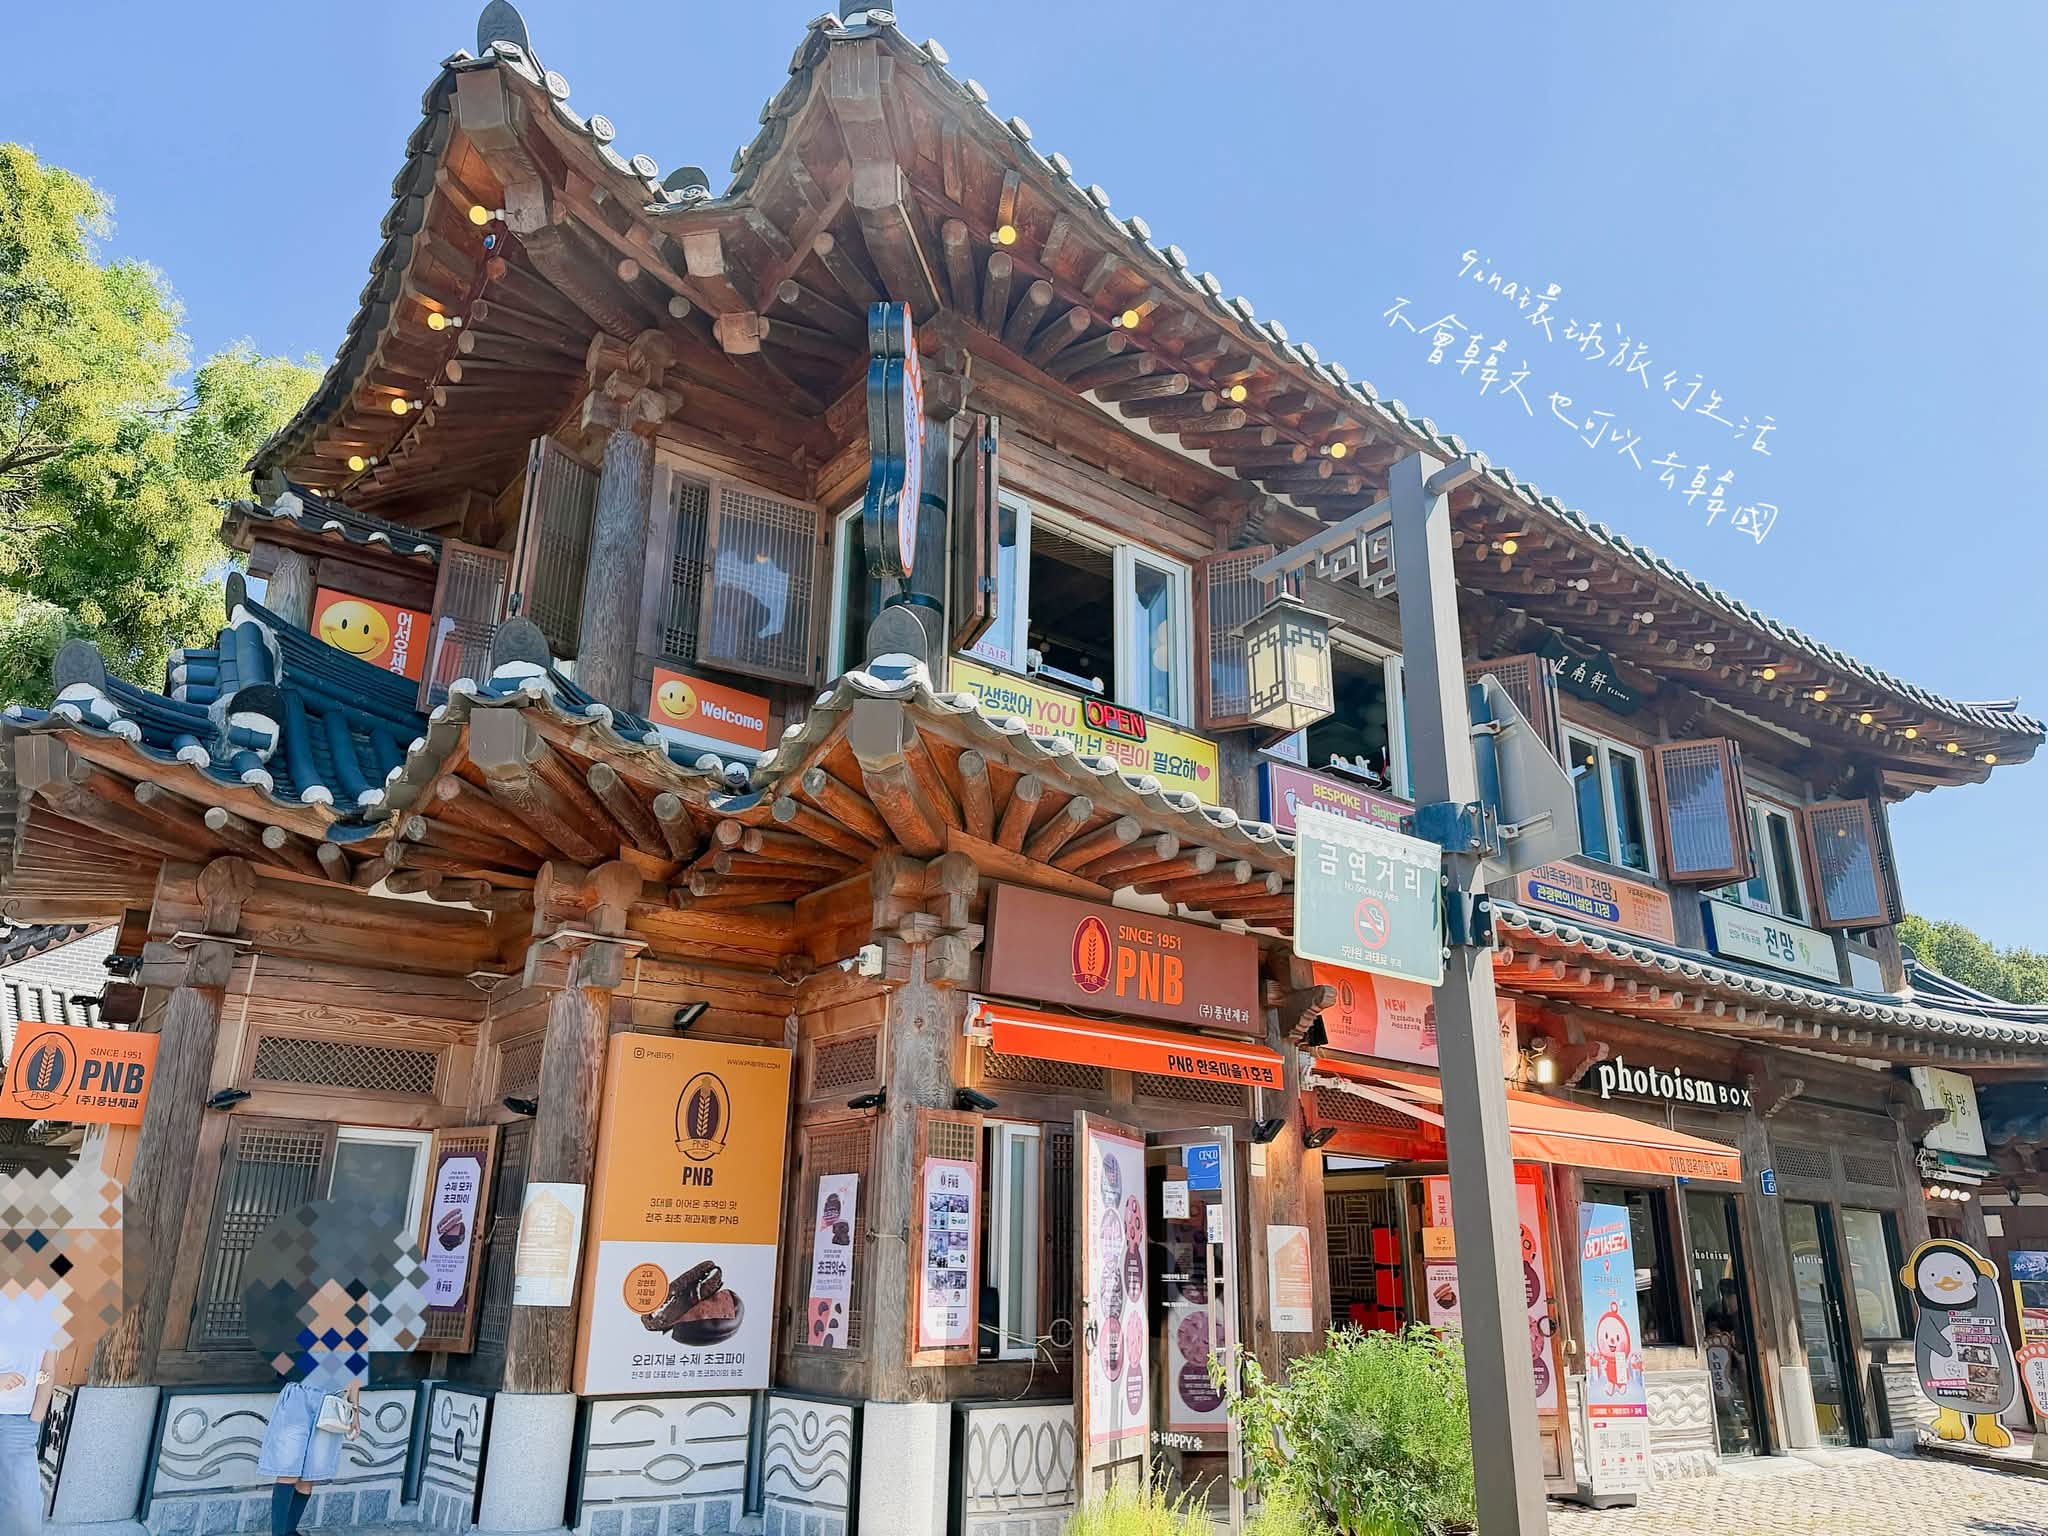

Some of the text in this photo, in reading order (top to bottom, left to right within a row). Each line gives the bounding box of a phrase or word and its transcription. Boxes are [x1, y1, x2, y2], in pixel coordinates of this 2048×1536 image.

[700, 699, 765, 732] Welcome
[1035, 698, 1077, 728] YOU
[1087, 700, 1145, 741] OPEN
[1153, 751, 1197, 781] 필요해
[1312, 783, 1361, 812] BESPOKE
[1317, 843, 1421, 898] 금연거리
[1119, 925, 1183, 950] SINCE 1951
[1762, 926, 1795, 962] 전망
[1115, 946, 1184, 1006] PNB
[1198, 1003, 1249, 1024] (주)풍년제과
[1384, 998, 1407, 1012] NEW
[90, 1047, 142, 1060] SINCE 1951
[1167, 1054, 1194, 1073] PNB
[79, 1059, 145, 1094] PNB
[1599, 1055, 1751, 1107] photoism BOX
[30, 1090, 50, 1100] PNB
[691, 1139, 710, 1149] PNB
[681, 1166, 714, 1187] PNB
[719, 1215, 739, 1225] PNB
[631, 1352, 745, 1366] 오리지널 수제 초코파이
[1161, 1432, 1193, 1450] HAPPY
